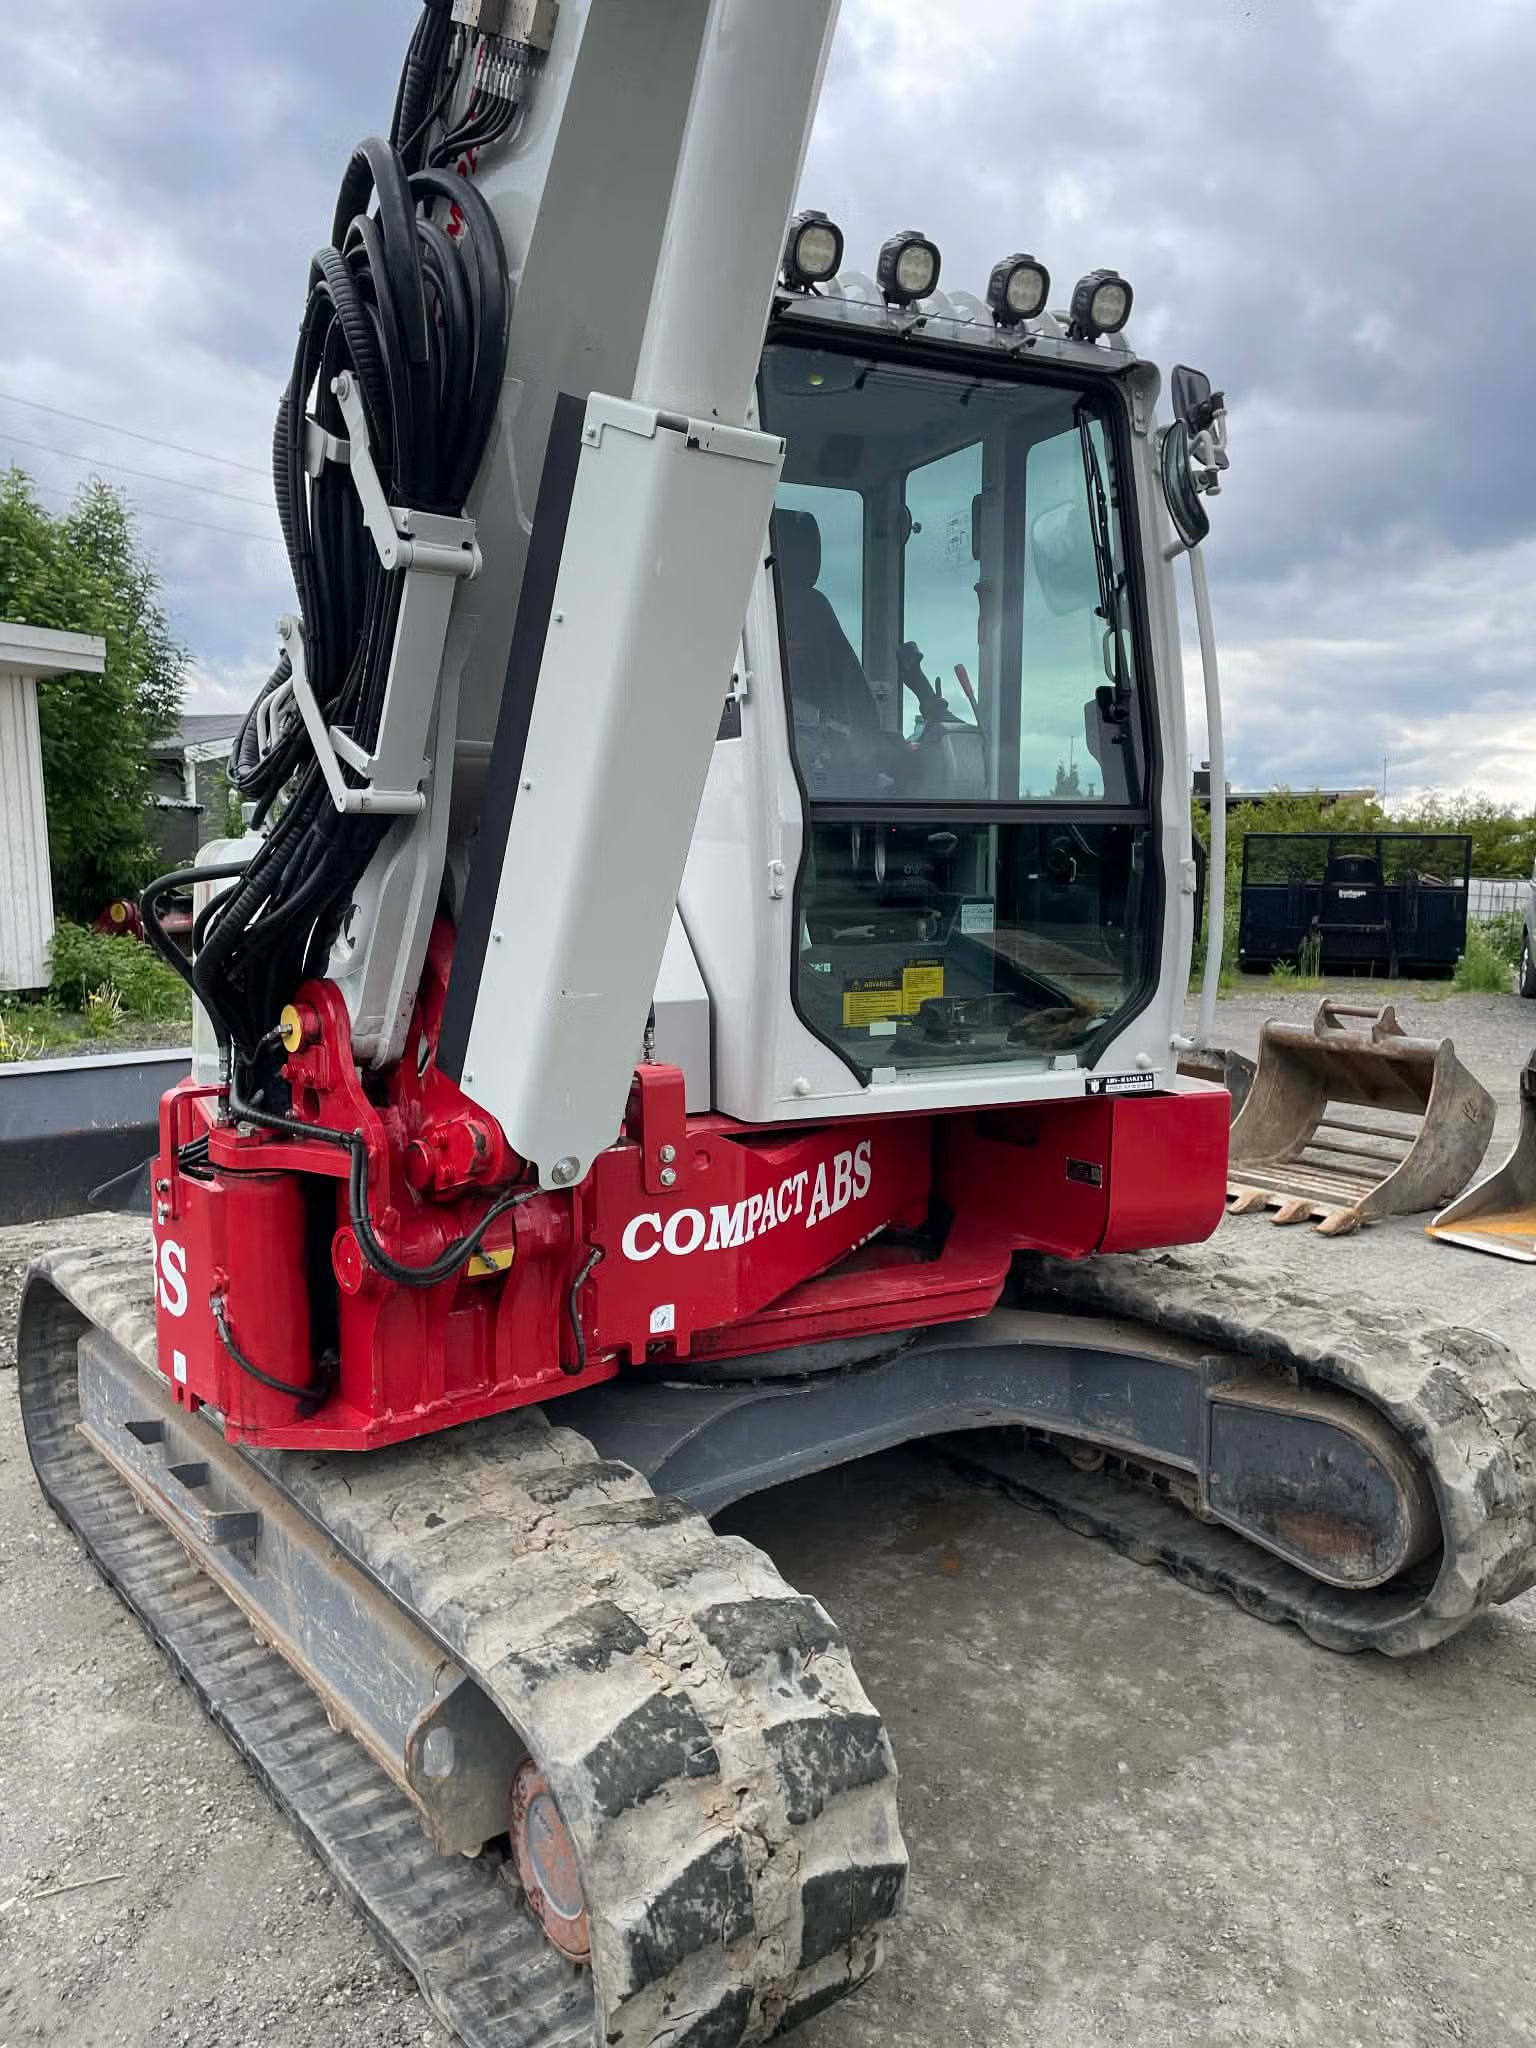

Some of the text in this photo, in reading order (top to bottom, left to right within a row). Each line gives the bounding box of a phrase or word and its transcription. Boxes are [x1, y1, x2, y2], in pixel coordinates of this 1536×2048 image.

[621, 1140, 872, 1262] COMPACT ABS
[152, 1231, 188, 1318] S
